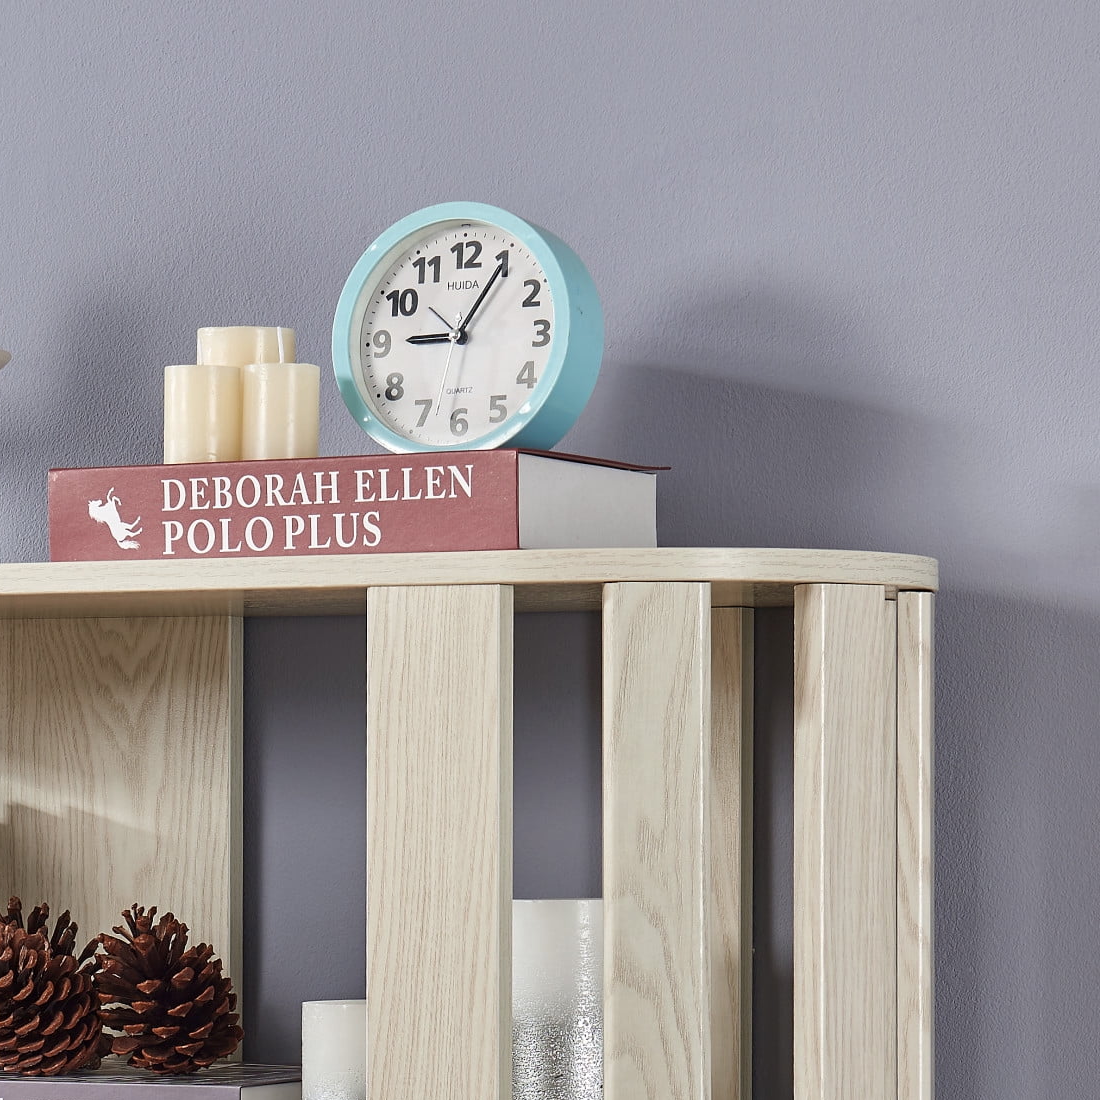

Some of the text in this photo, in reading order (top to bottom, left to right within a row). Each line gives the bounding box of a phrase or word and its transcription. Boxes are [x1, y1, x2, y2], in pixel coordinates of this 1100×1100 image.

[451, 241, 483, 270] 12
[496, 250, 509, 278] 1
[413, 256, 441, 284] 11
[447, 279, 480, 291] HUIDA
[522, 279, 541, 307] 2
[386, 289, 419, 317] 10
[373, 330, 392, 358] 9
[532, 320, 551, 347] 3
[385, 373, 404, 401] 8
[516, 361, 537, 389] 4
[414, 399, 433, 427] 7
[450, 408, 469, 437] 6
[489, 395, 508, 423] 5
[161, 465, 474, 512] DEBORAH ELLEN
[162, 511, 382, 555] POLO PLUS
